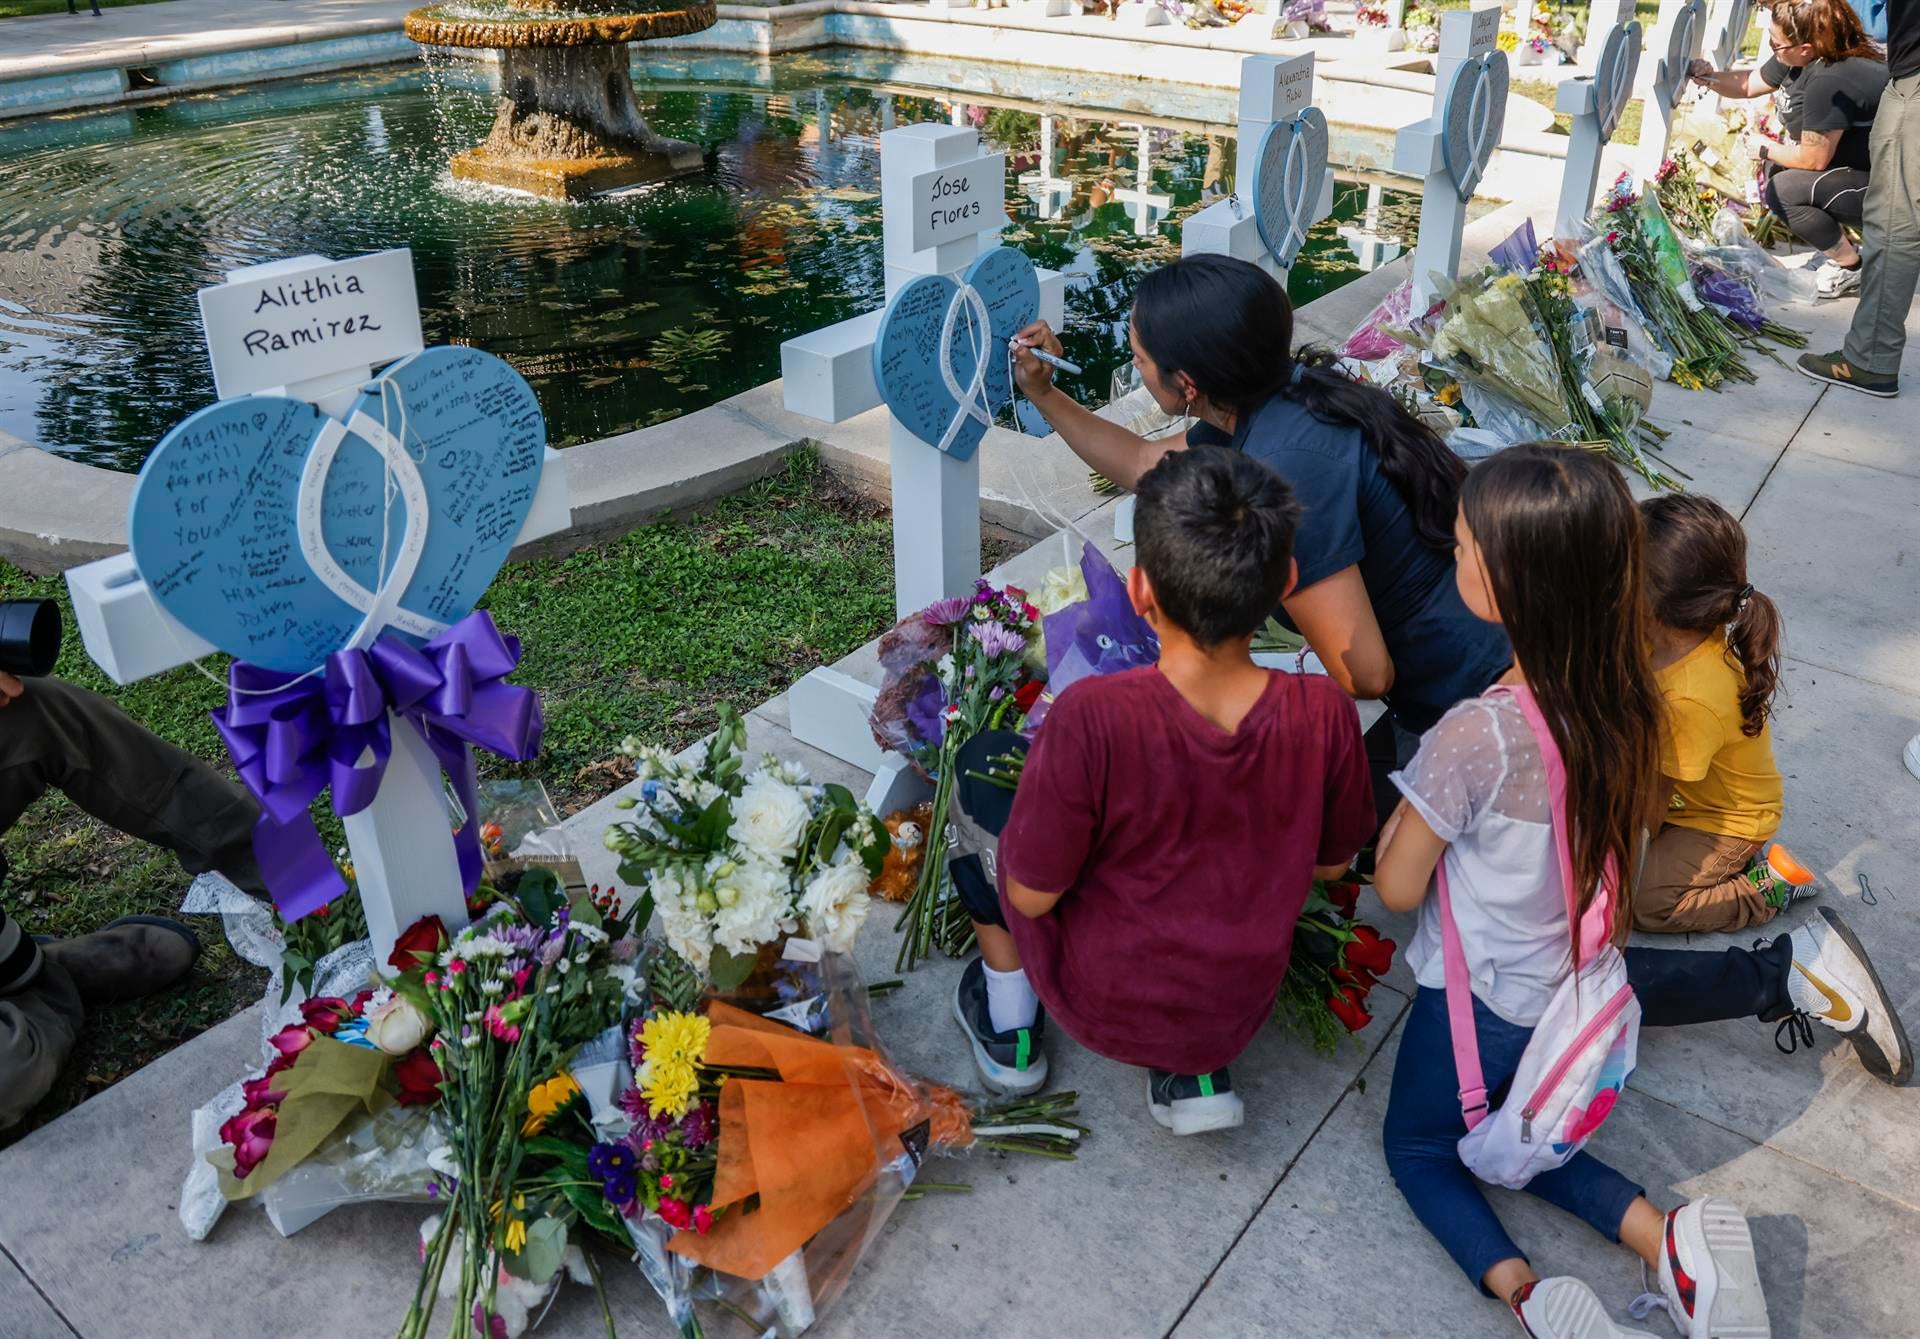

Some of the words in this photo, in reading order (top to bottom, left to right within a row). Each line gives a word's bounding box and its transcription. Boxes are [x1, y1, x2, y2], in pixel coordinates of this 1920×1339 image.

[1278, 64, 1310, 88] Alexandria
[1286, 88, 1303, 104] Rubio
[931, 175, 970, 202] Jose
[931, 201, 980, 230] Flores
[253, 273, 365, 314] Alithia
[242, 312, 382, 357] Ramirez
